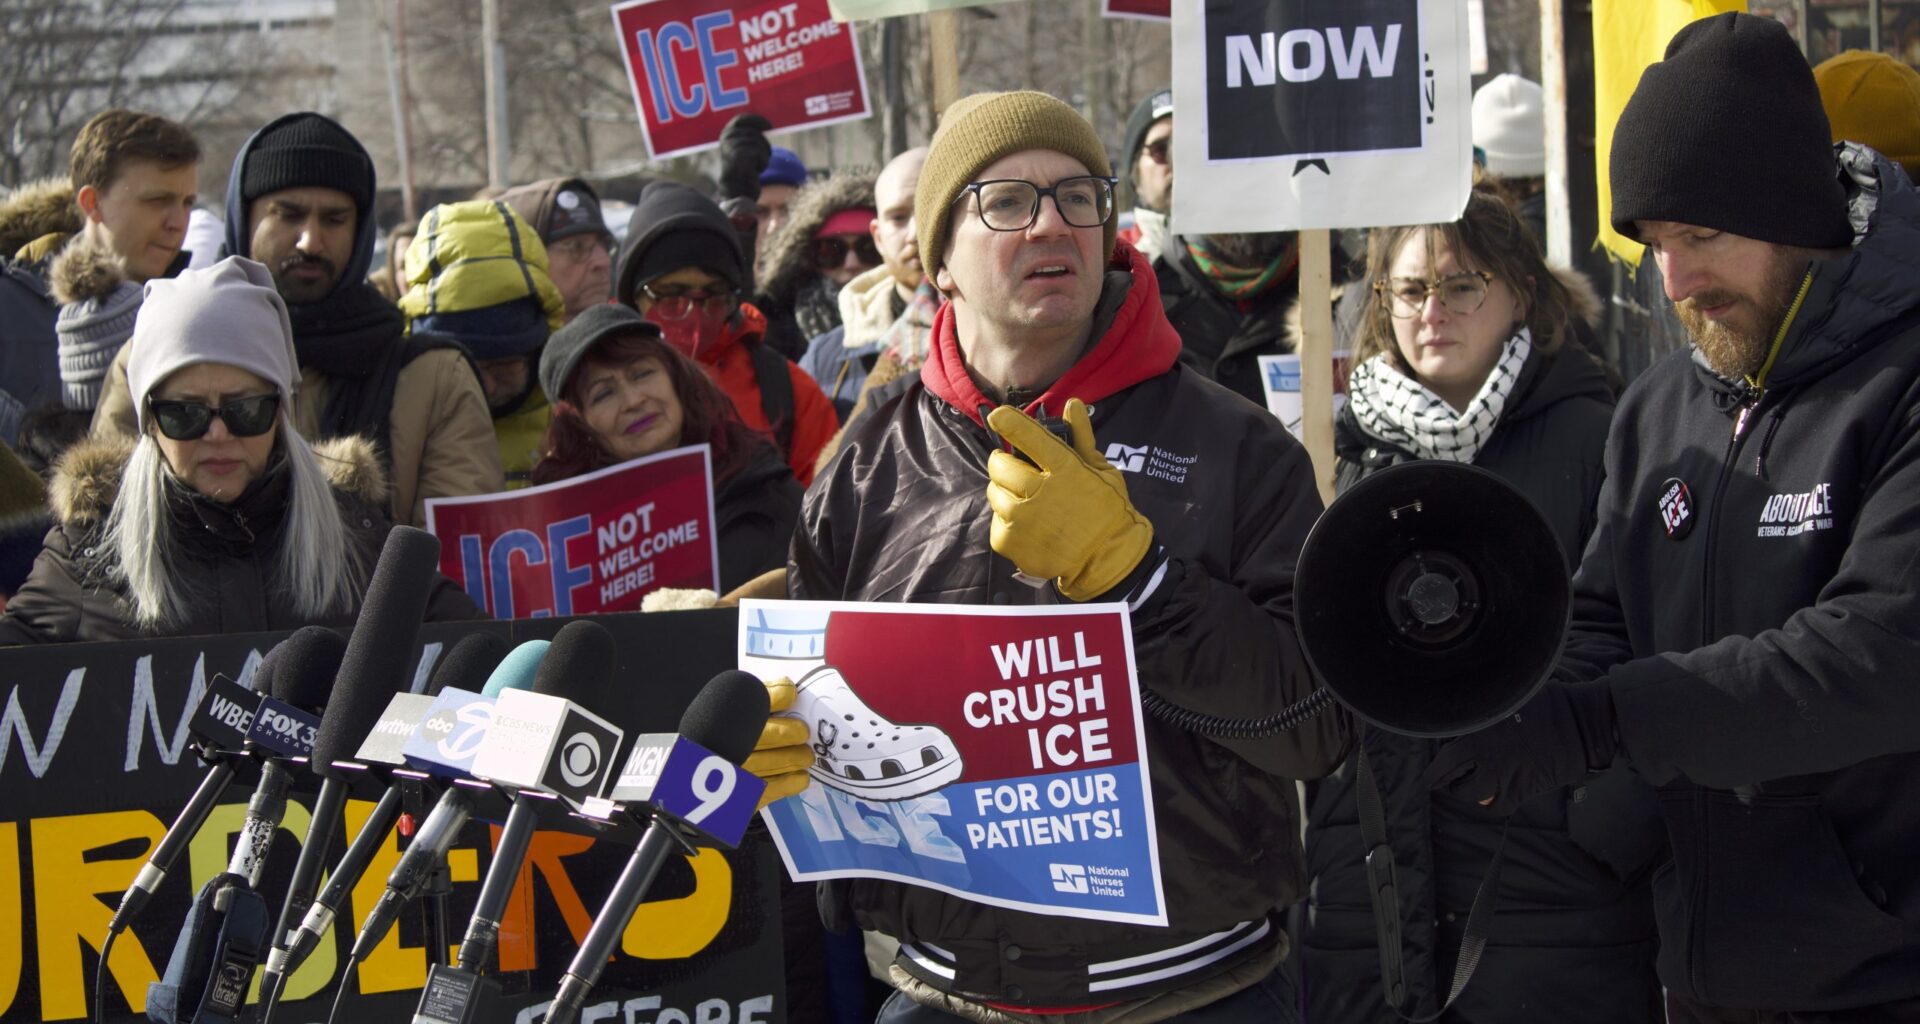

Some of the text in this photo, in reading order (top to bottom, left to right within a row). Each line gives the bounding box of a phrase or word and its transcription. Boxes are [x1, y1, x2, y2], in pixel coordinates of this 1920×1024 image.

[739, 3, 798, 43] NOT
[743, 21, 841, 63] WELCOME
[637, 9, 749, 123] ICE
[747, 51, 804, 84] HERE!
[1225, 23, 1402, 88] NOW
[1146, 466, 1185, 484] United
[1149, 457, 1188, 474] Nurses
[1152, 446, 1198, 464] National
[1658, 482, 1680, 511] ABOLISH
[1661, 491, 1690, 535] ICE
[597, 501, 655, 554] NOT
[1757, 526, 1787, 537] VETERANS
[1815, 518, 1833, 530] WAR
[459, 513, 593, 621] ICE
[599, 519, 699, 580] WELCOME
[601, 562, 655, 605] HERE!
[991, 631, 1102, 680] WILL
[963, 673, 1106, 728] CRUSH
[259, 707, 318, 748] FOX 3
[425, 716, 455, 734] abc
[1028, 718, 1112, 769] ICE
[626, 746, 671, 776] WGN
[684, 755, 737, 825] 9
[974, 773, 1119, 816] FOR OUR
[966, 808, 1123, 849] PATIENTS!
[1087, 865, 1130, 878] National
[1090, 876, 1124, 888] Nurses
[1092, 886, 1126, 898] United
